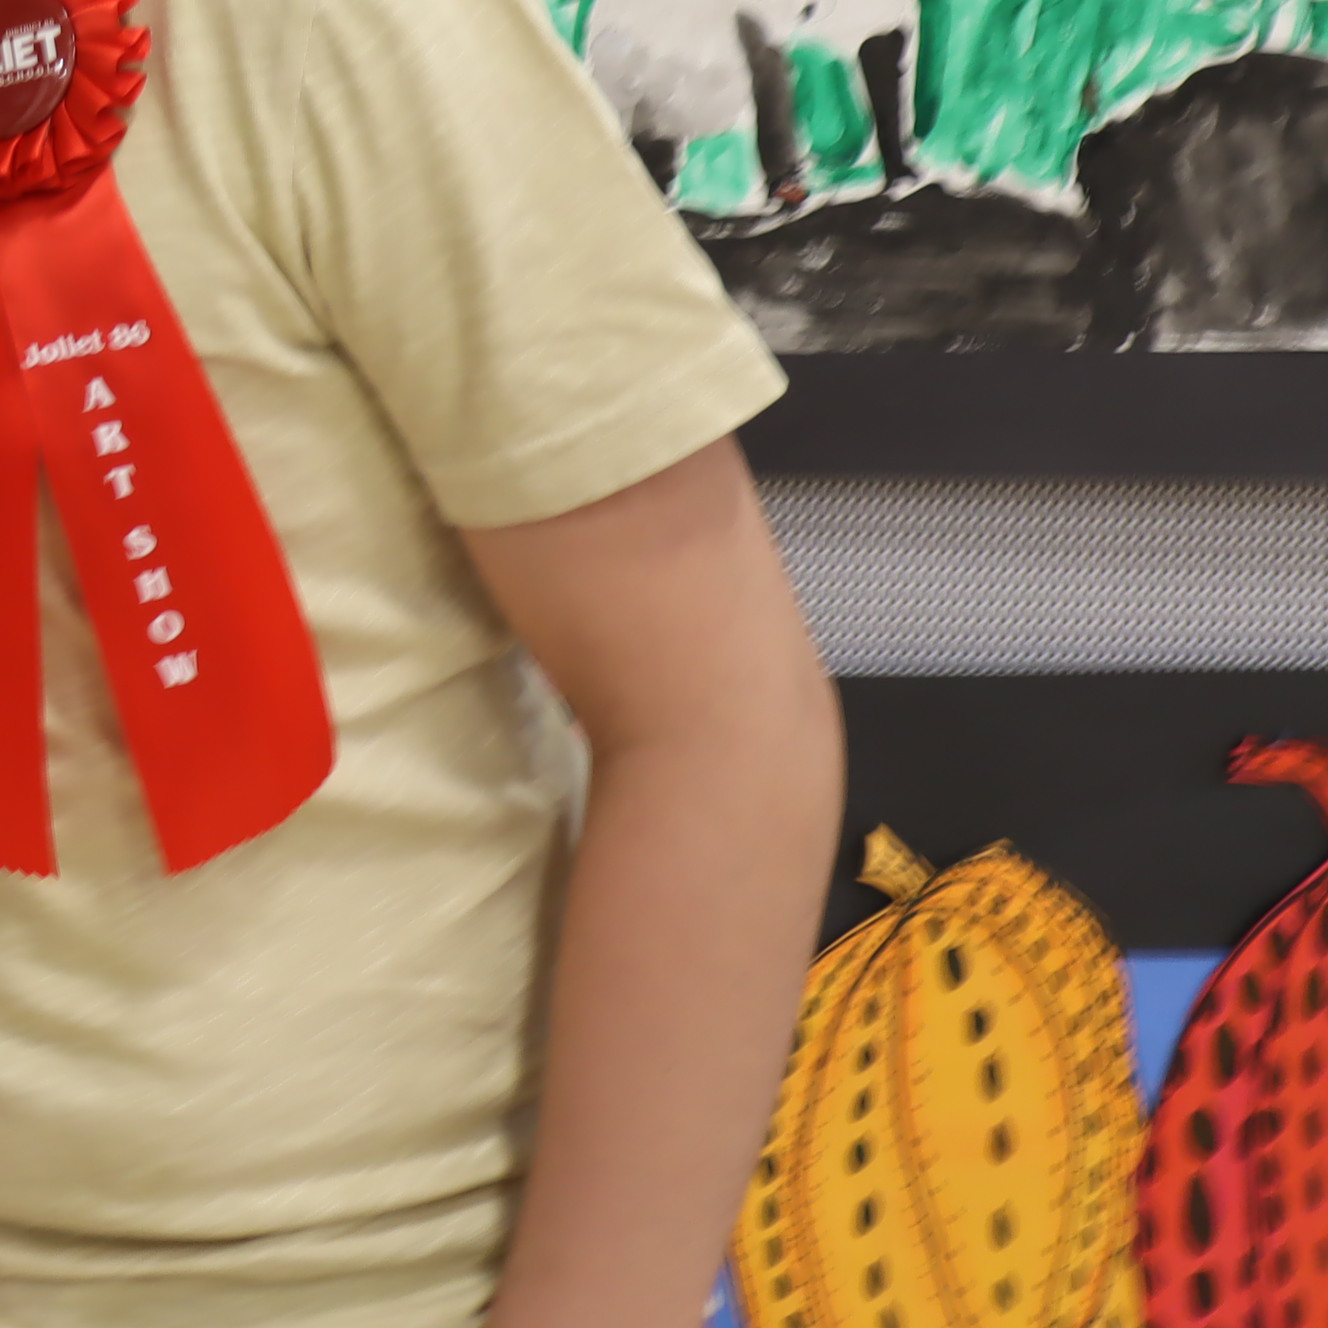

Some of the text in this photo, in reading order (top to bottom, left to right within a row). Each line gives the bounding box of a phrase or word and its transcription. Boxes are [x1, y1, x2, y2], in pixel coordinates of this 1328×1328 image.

[20, 328, 106, 370] Joliet
[81, 375, 137, 501] ART
[122, 523, 200, 690] SHOW
